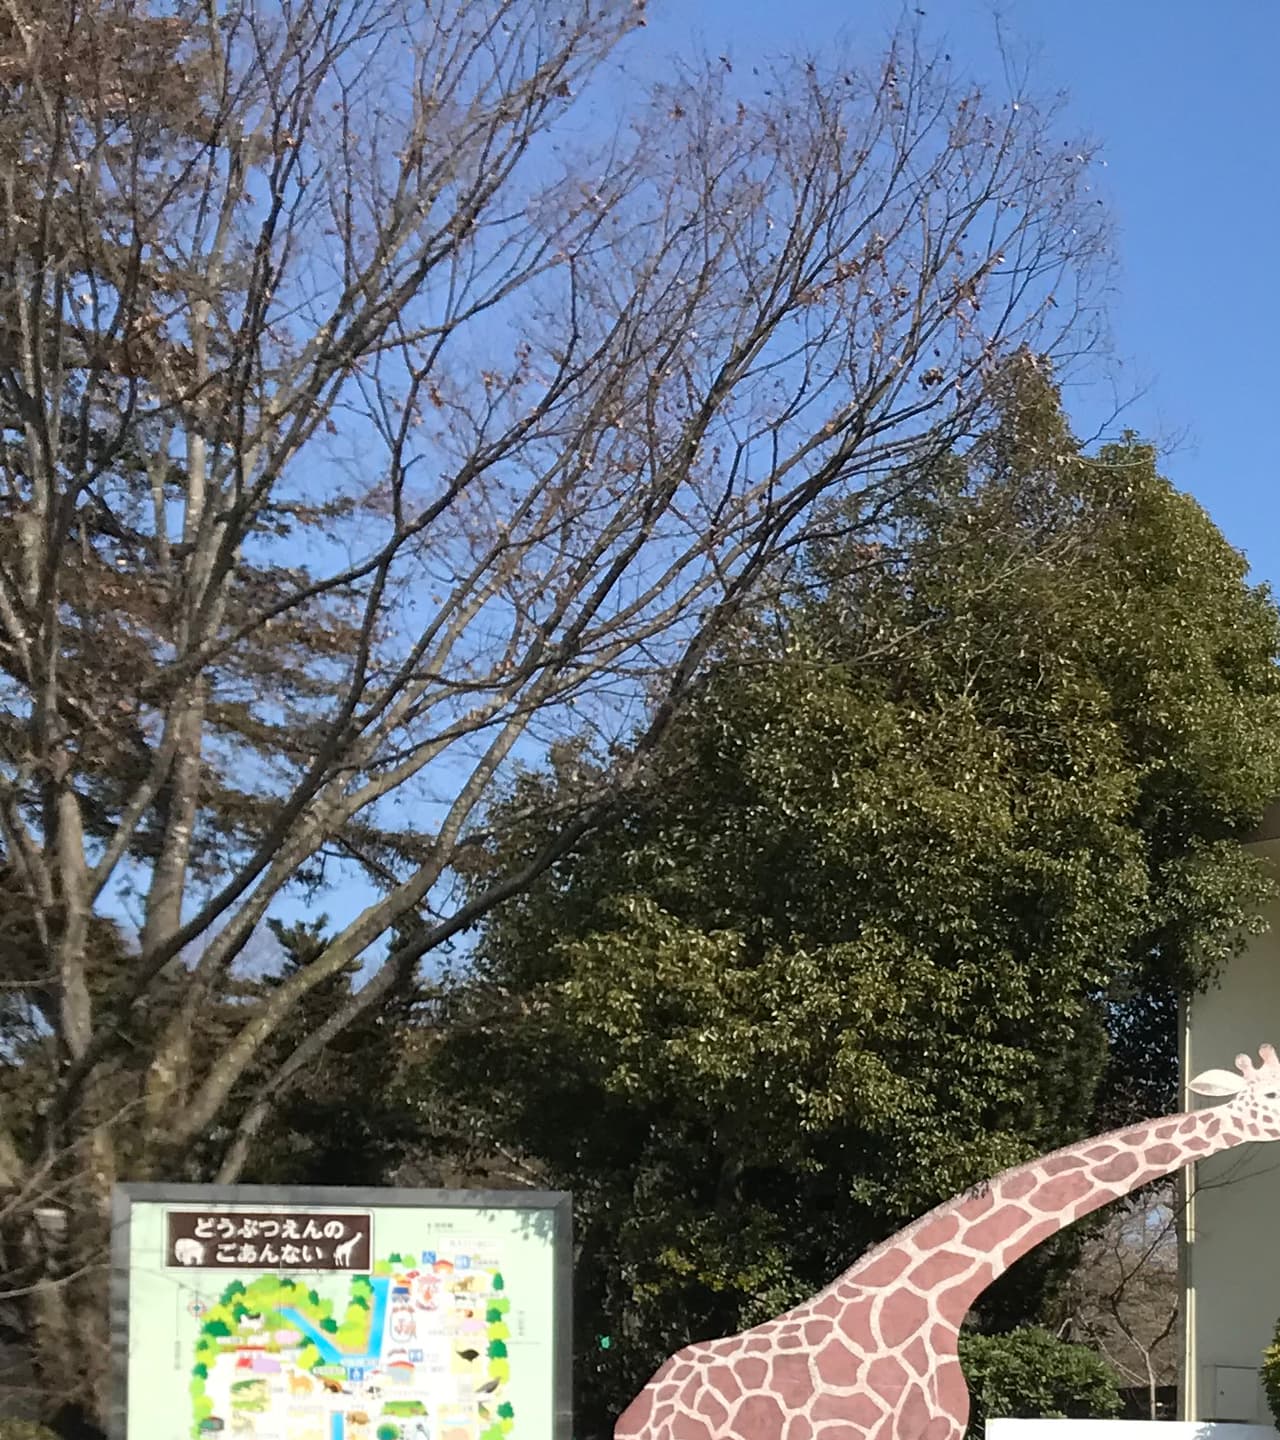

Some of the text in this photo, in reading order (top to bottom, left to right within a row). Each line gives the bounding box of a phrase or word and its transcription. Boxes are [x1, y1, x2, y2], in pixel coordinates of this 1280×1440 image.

[194, 1217, 344, 1239] どうぶつえんの
[216, 1243, 323, 1264] ごあんない
